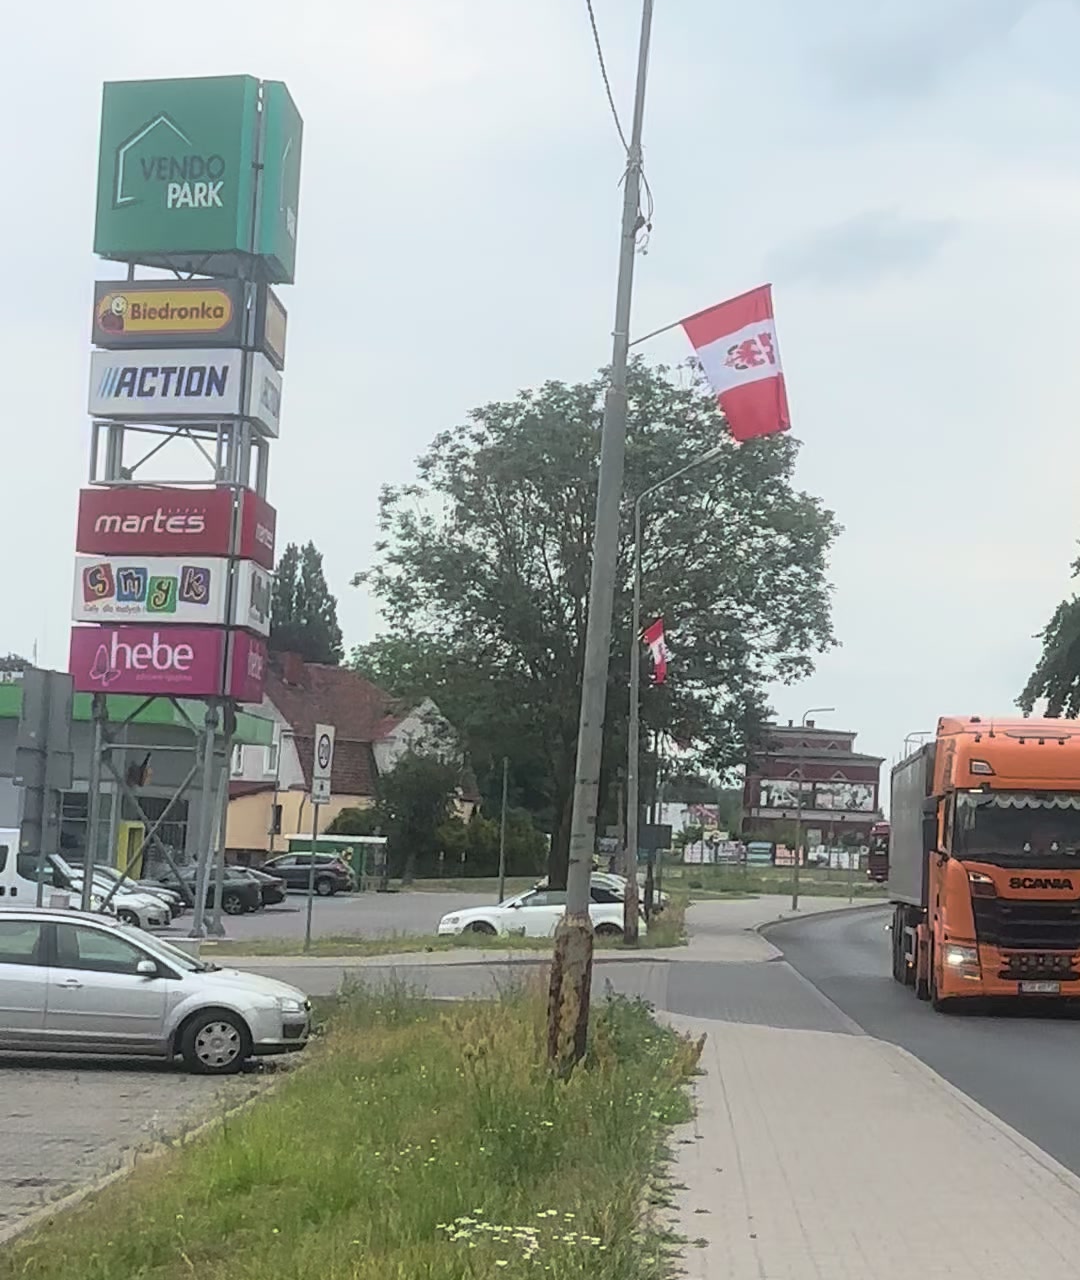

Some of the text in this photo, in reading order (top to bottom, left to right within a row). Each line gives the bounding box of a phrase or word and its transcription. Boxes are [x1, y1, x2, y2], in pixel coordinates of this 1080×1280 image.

[140, 154, 225, 181] VENDO
[167, 182, 224, 209] PARK
[130, 302, 225, 321] Biedronka
[114, 366, 229, 399] ACTION
[94, 507, 205, 533] martes
[110, 631, 194, 670] hebe
[1009, 877, 1074, 890] SCANIA
